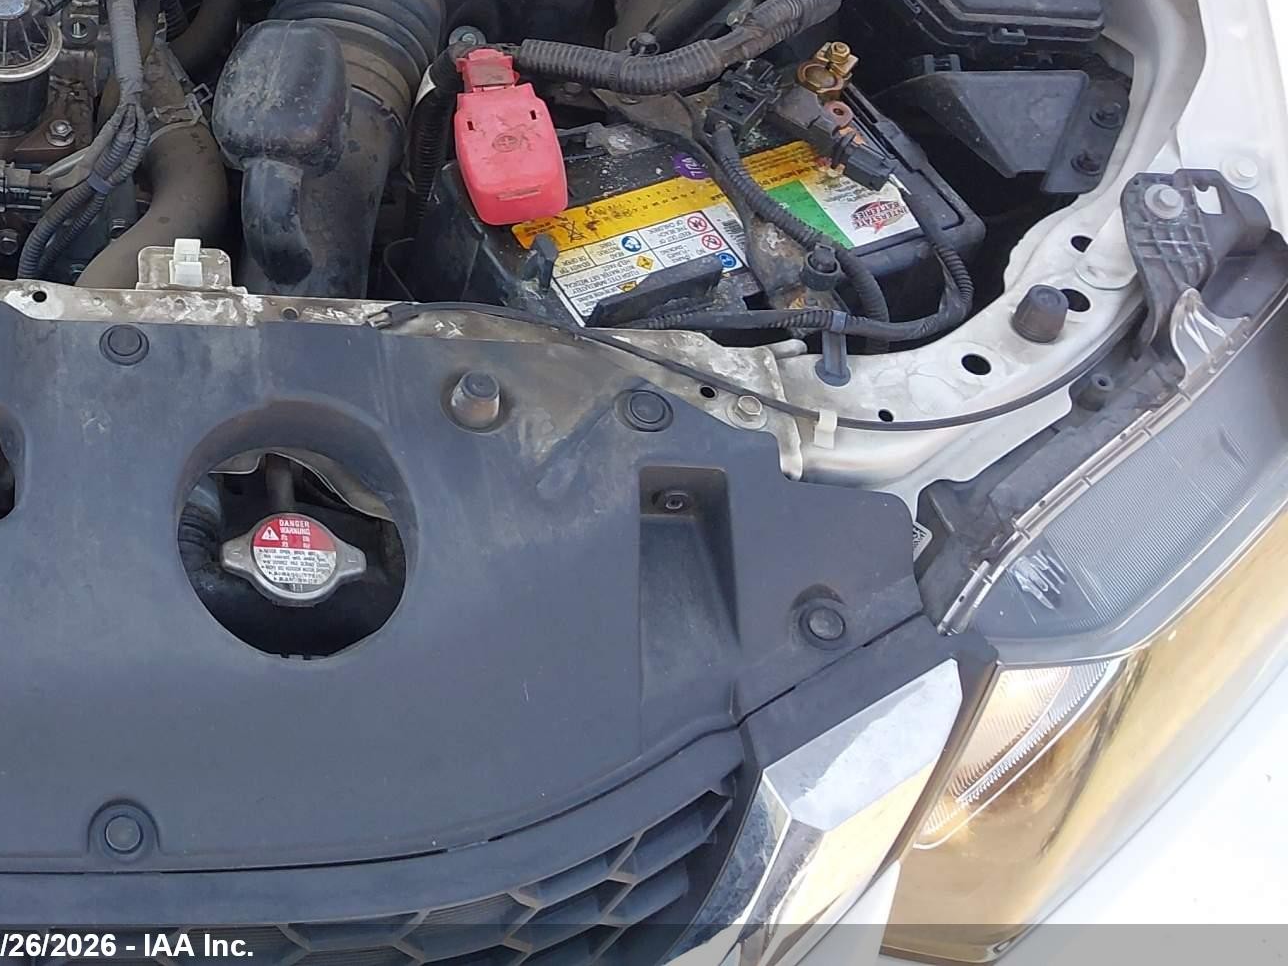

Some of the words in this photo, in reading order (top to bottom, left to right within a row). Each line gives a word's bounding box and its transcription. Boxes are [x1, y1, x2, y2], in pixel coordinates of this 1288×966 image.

[852, 202, 899, 219] BATTERIES
[853, 208, 908, 228] INTERSTATE
[280, 520, 309, 528] DANGER
[280, 527, 310, 535] WARNING
